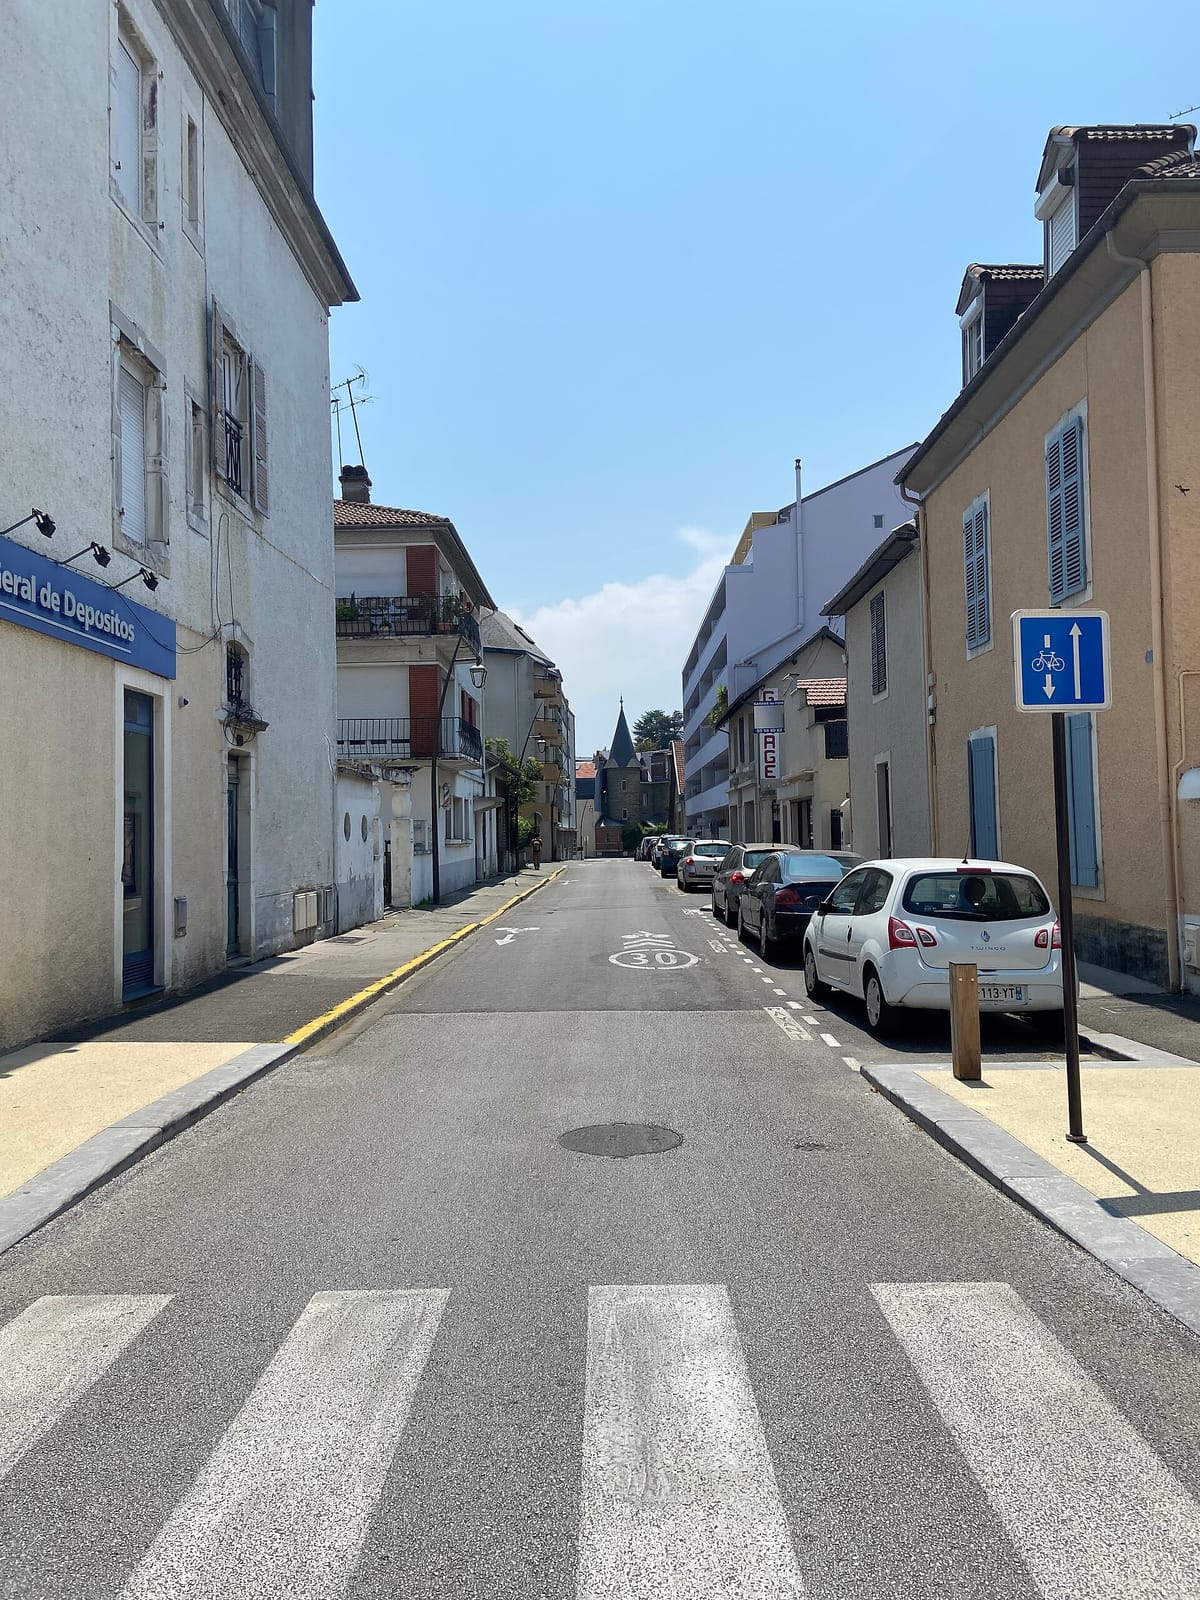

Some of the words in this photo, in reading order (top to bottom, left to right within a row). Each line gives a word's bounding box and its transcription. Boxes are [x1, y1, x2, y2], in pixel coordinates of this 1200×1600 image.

[0, 569, 36, 603] eral
[40, 582, 60, 612] de
[763, 691, 776, 778] GAGE
[630, 952, 677, 964] 30
[978, 987, 1014, 999] -113-YT
